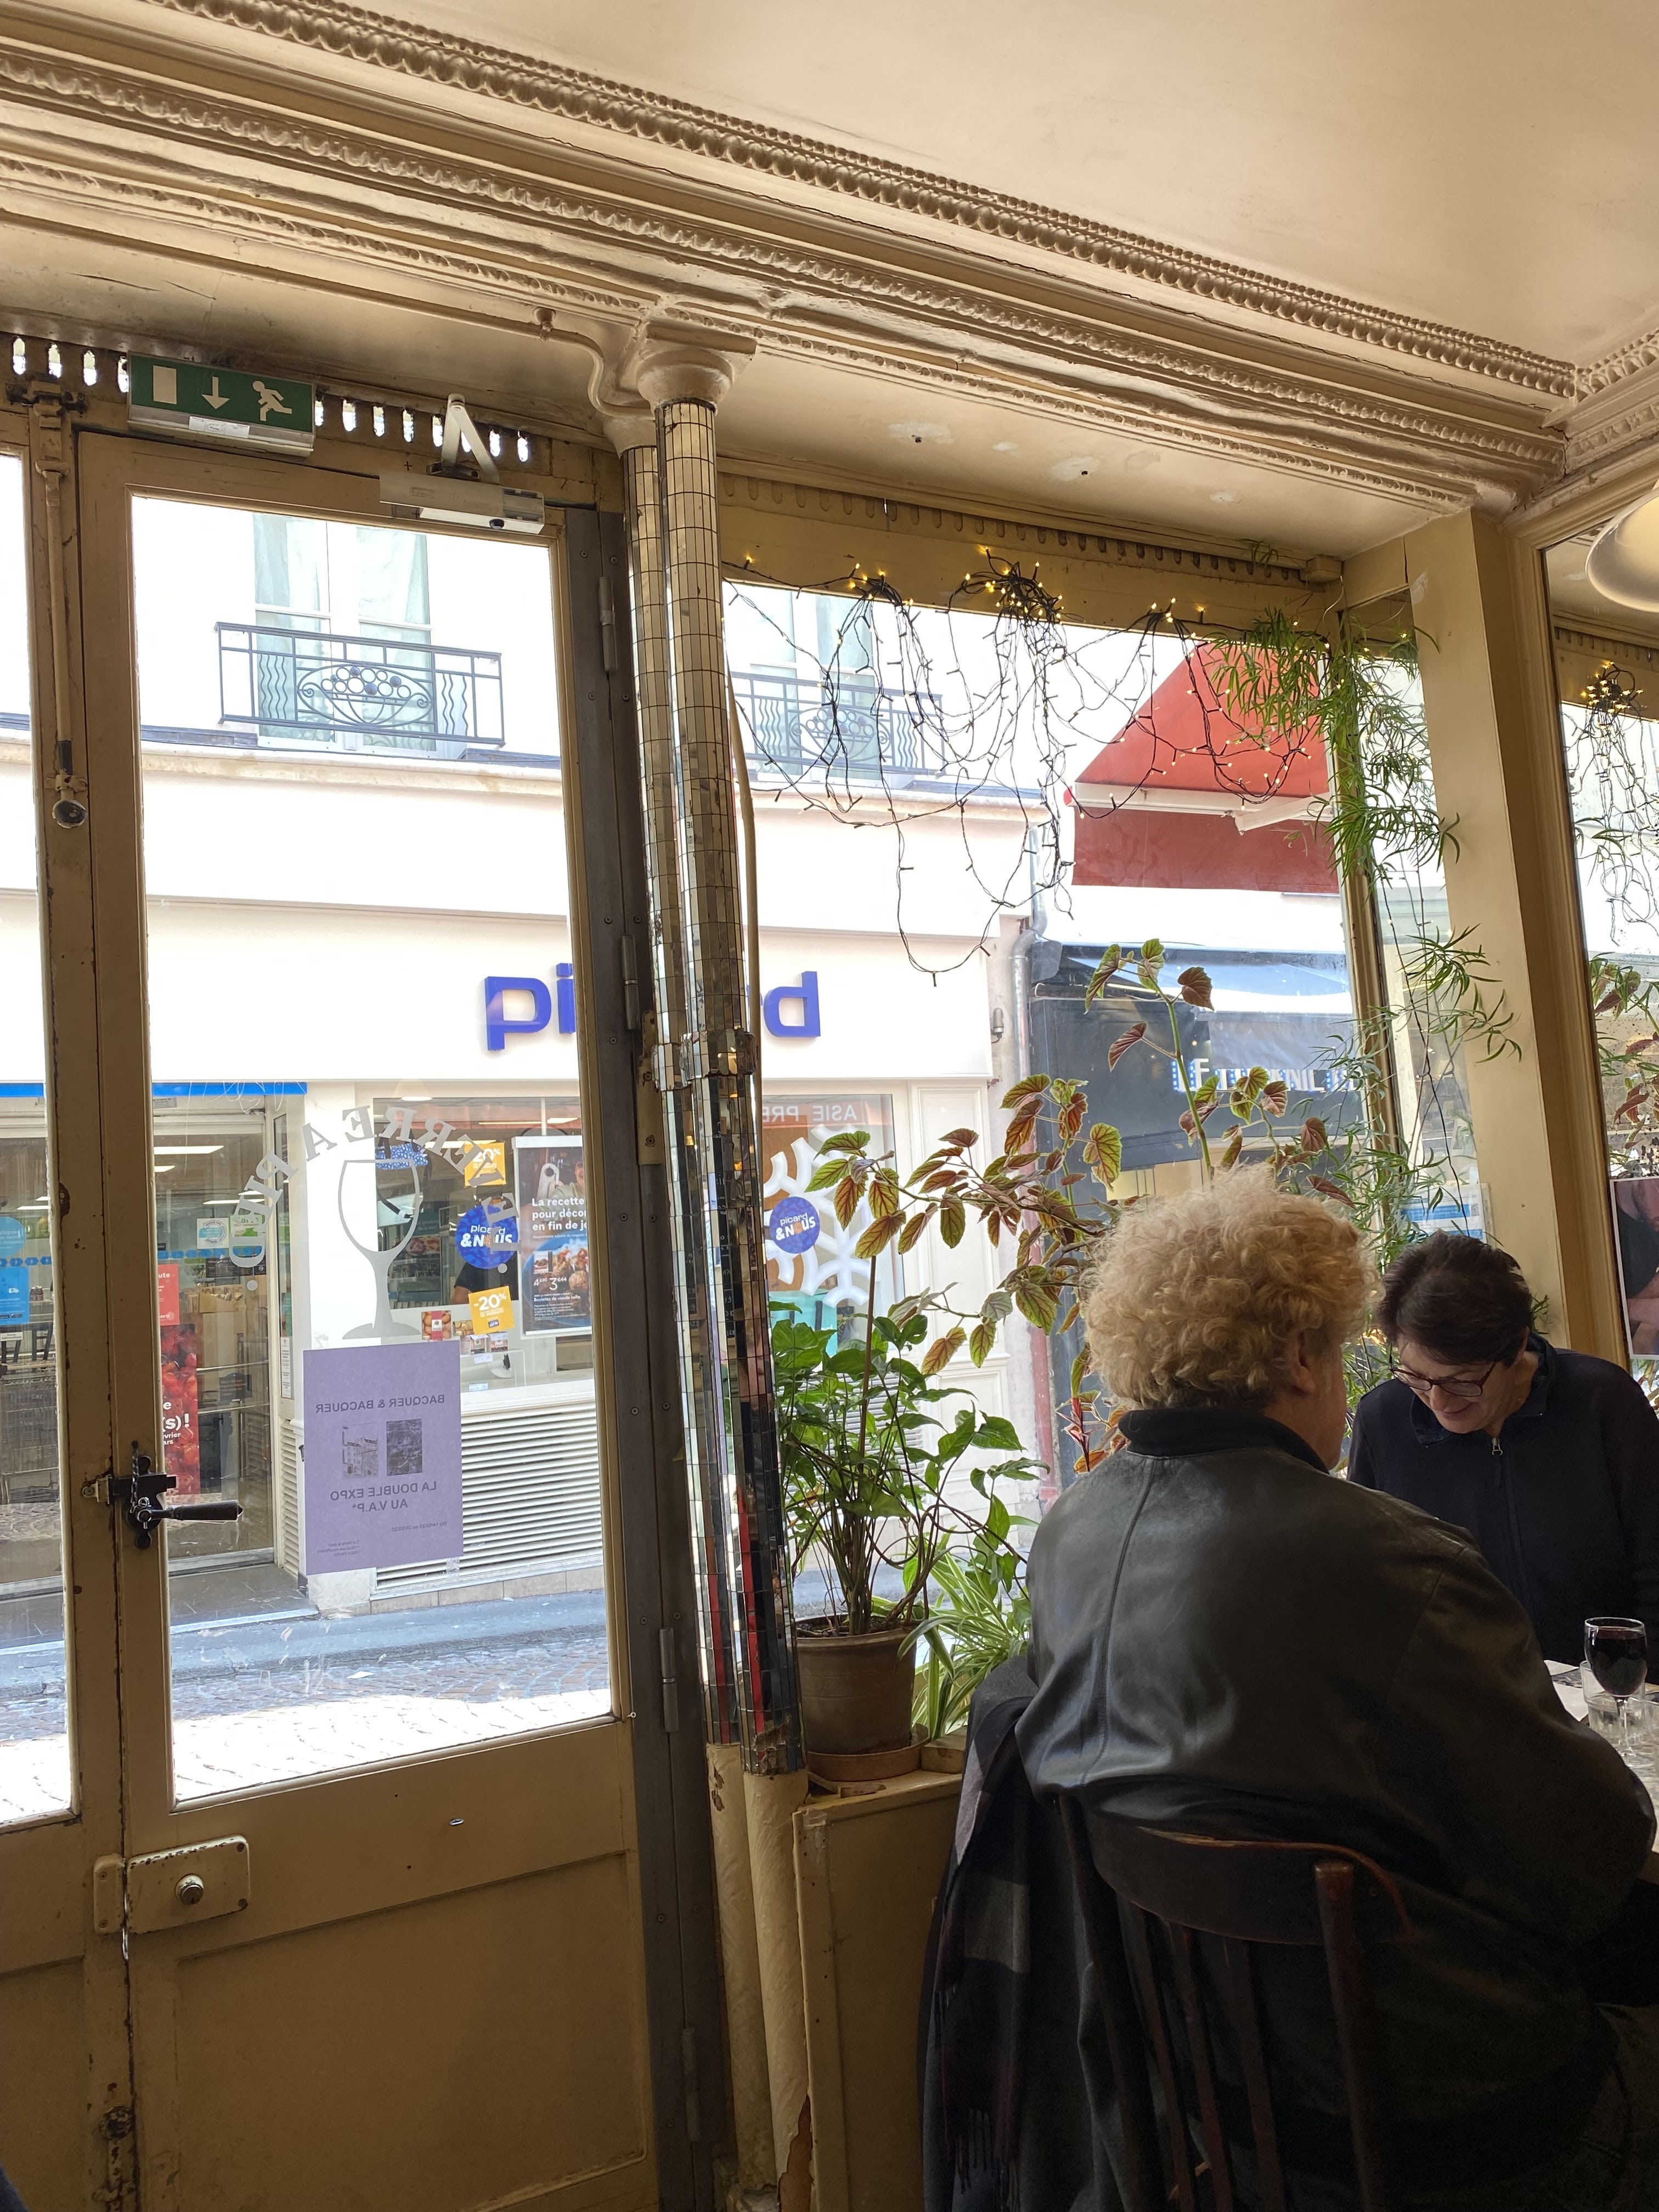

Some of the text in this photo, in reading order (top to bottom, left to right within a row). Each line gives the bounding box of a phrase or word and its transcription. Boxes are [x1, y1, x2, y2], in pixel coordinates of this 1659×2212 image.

[532, 1197, 585, 1206] La recette
[532, 1211, 556, 1221] pour
[780, 1212, 808, 1227] picard
[470, 1224, 506, 1235] picad
[548, 1221, 562, 1230] fin
[565, 1220, 578, 1229] de
[473, 1292, 507, 1311] -20%
